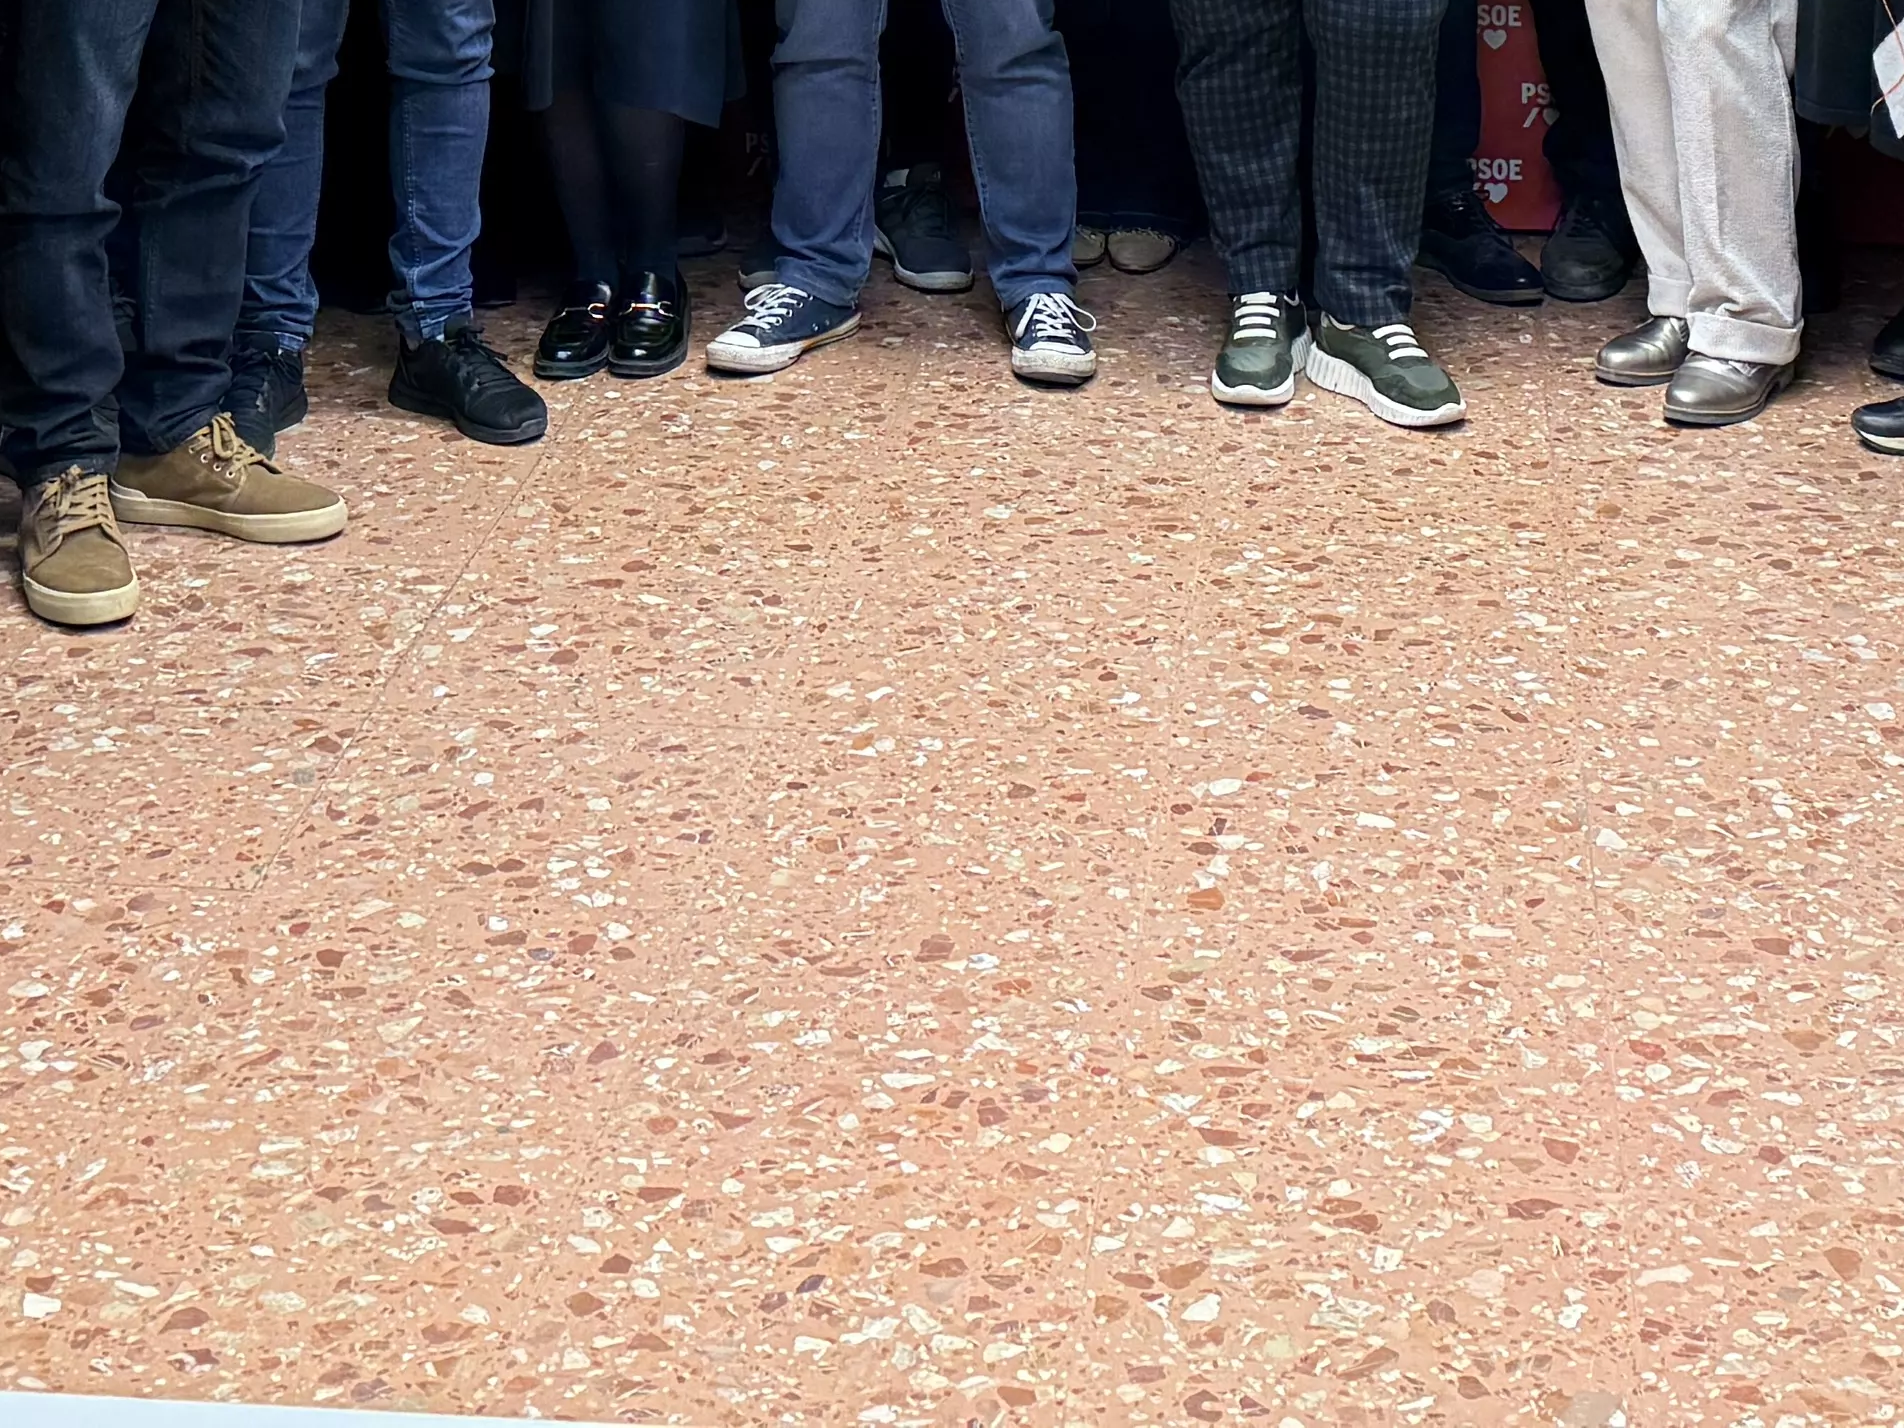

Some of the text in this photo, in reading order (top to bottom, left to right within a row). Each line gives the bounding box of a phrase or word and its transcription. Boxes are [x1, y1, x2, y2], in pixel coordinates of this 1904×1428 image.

[1476, 3, 1523, 28] SOE
[1520, 82, 1552, 106] PS
[745, 132, 770, 154] PS
